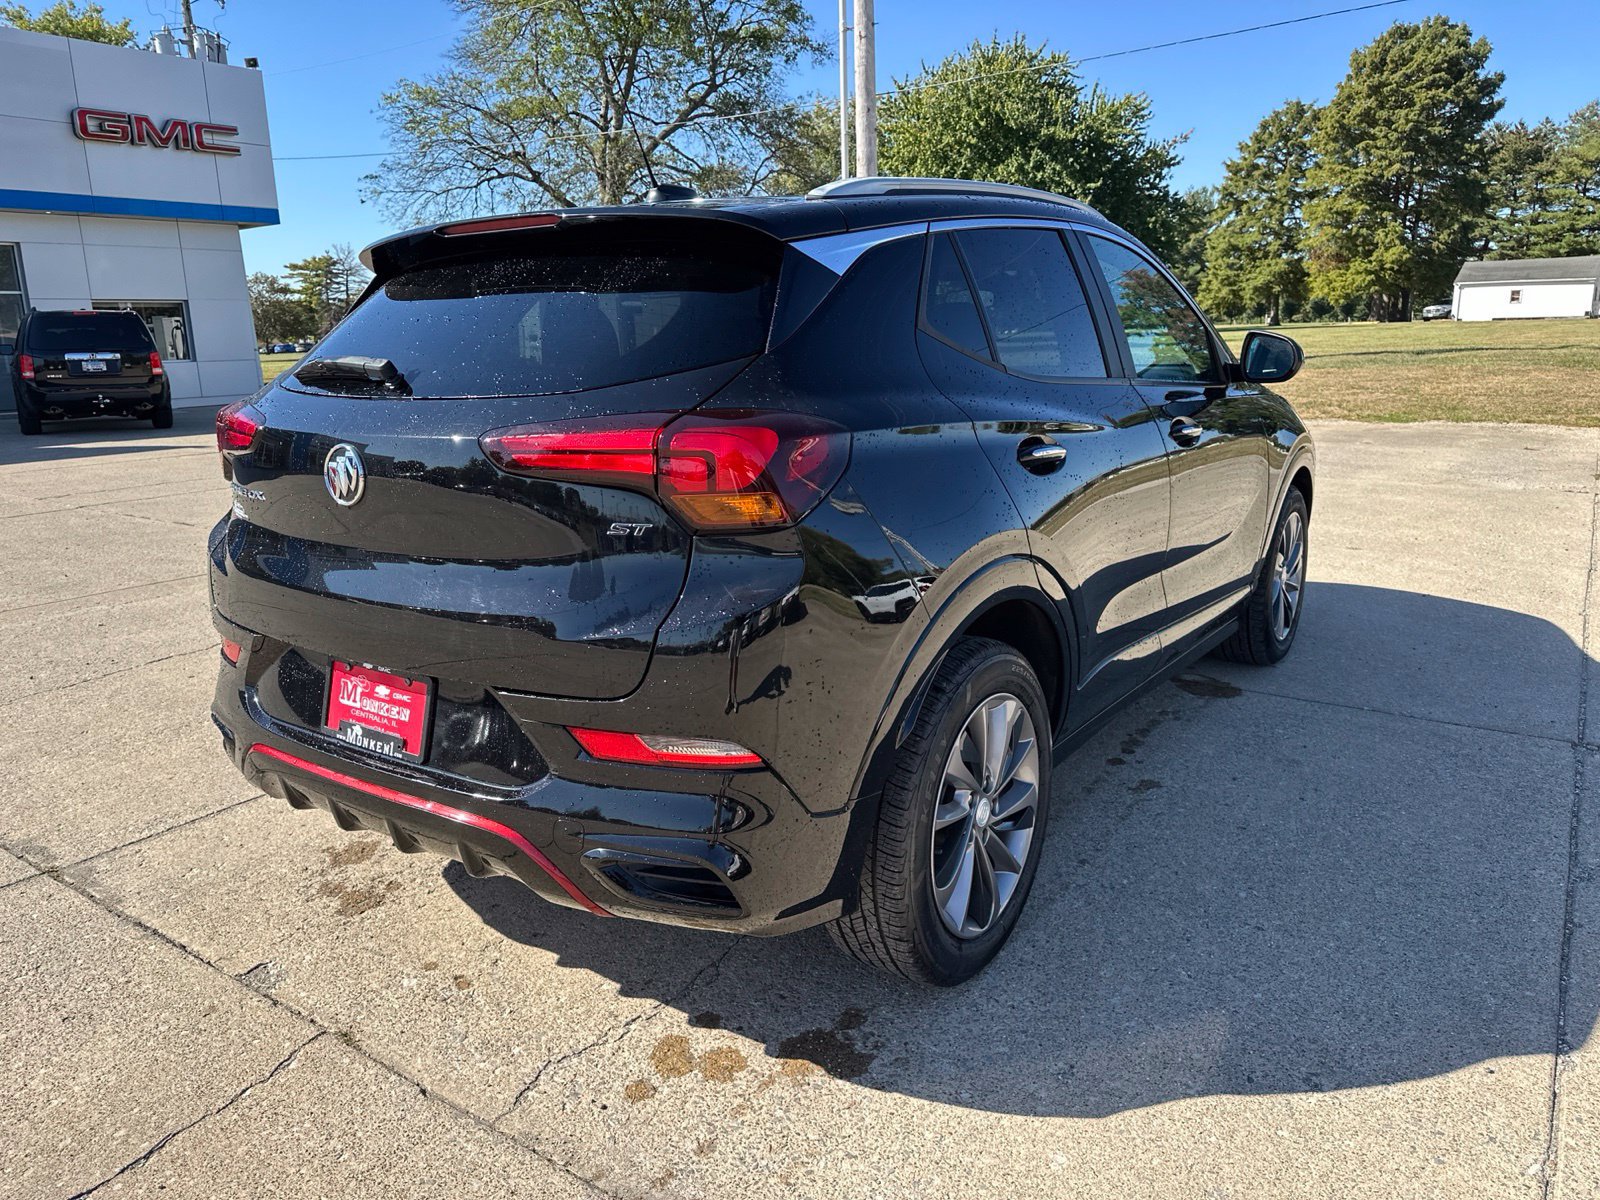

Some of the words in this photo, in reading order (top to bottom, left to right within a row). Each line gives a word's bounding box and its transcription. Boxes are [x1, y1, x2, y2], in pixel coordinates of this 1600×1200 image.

[71, 106, 241, 156] GMC
[606, 522, 653, 536] ST
[392, 692, 412, 702] GMC
[350, 708, 391, 727] CENTRALIA,
